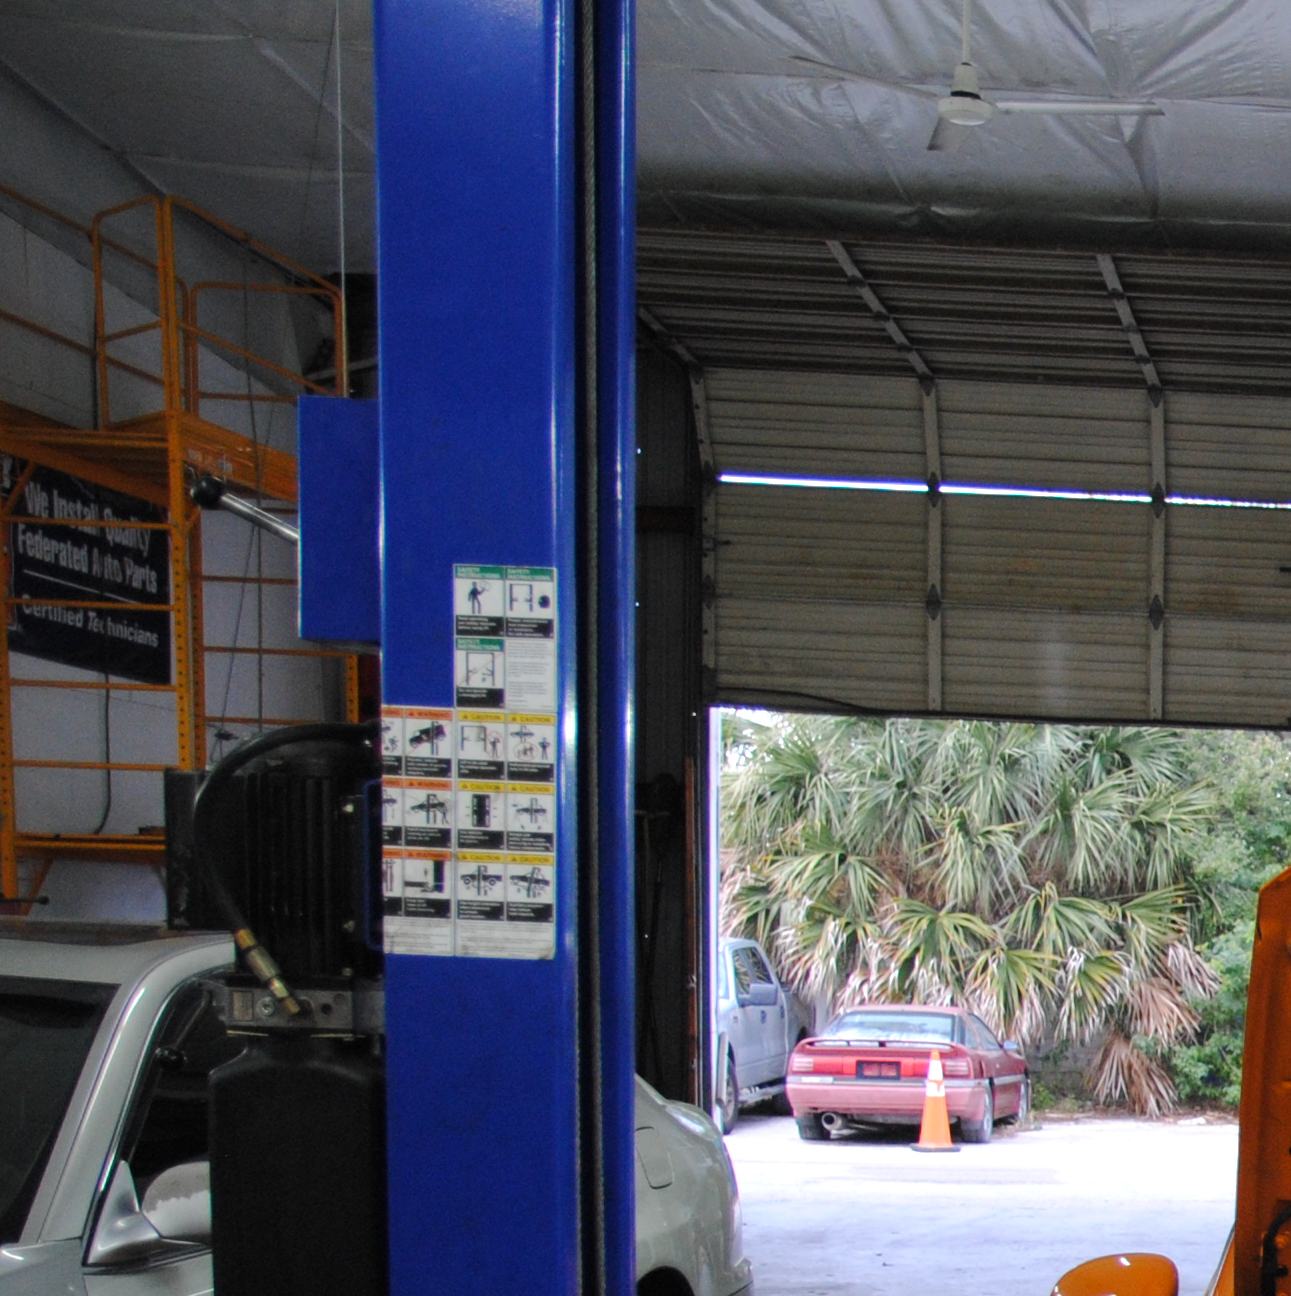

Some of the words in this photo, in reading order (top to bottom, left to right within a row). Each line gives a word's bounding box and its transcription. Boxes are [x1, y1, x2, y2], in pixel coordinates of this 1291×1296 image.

[25, 481, 49, 517] We
[53, 490, 100, 538] Install
[18, 523, 88, 573] Federated
[125, 558, 157, 594] Parts
[21, 594, 84, 627] Certified
[87, 611, 159, 647] Technicians
